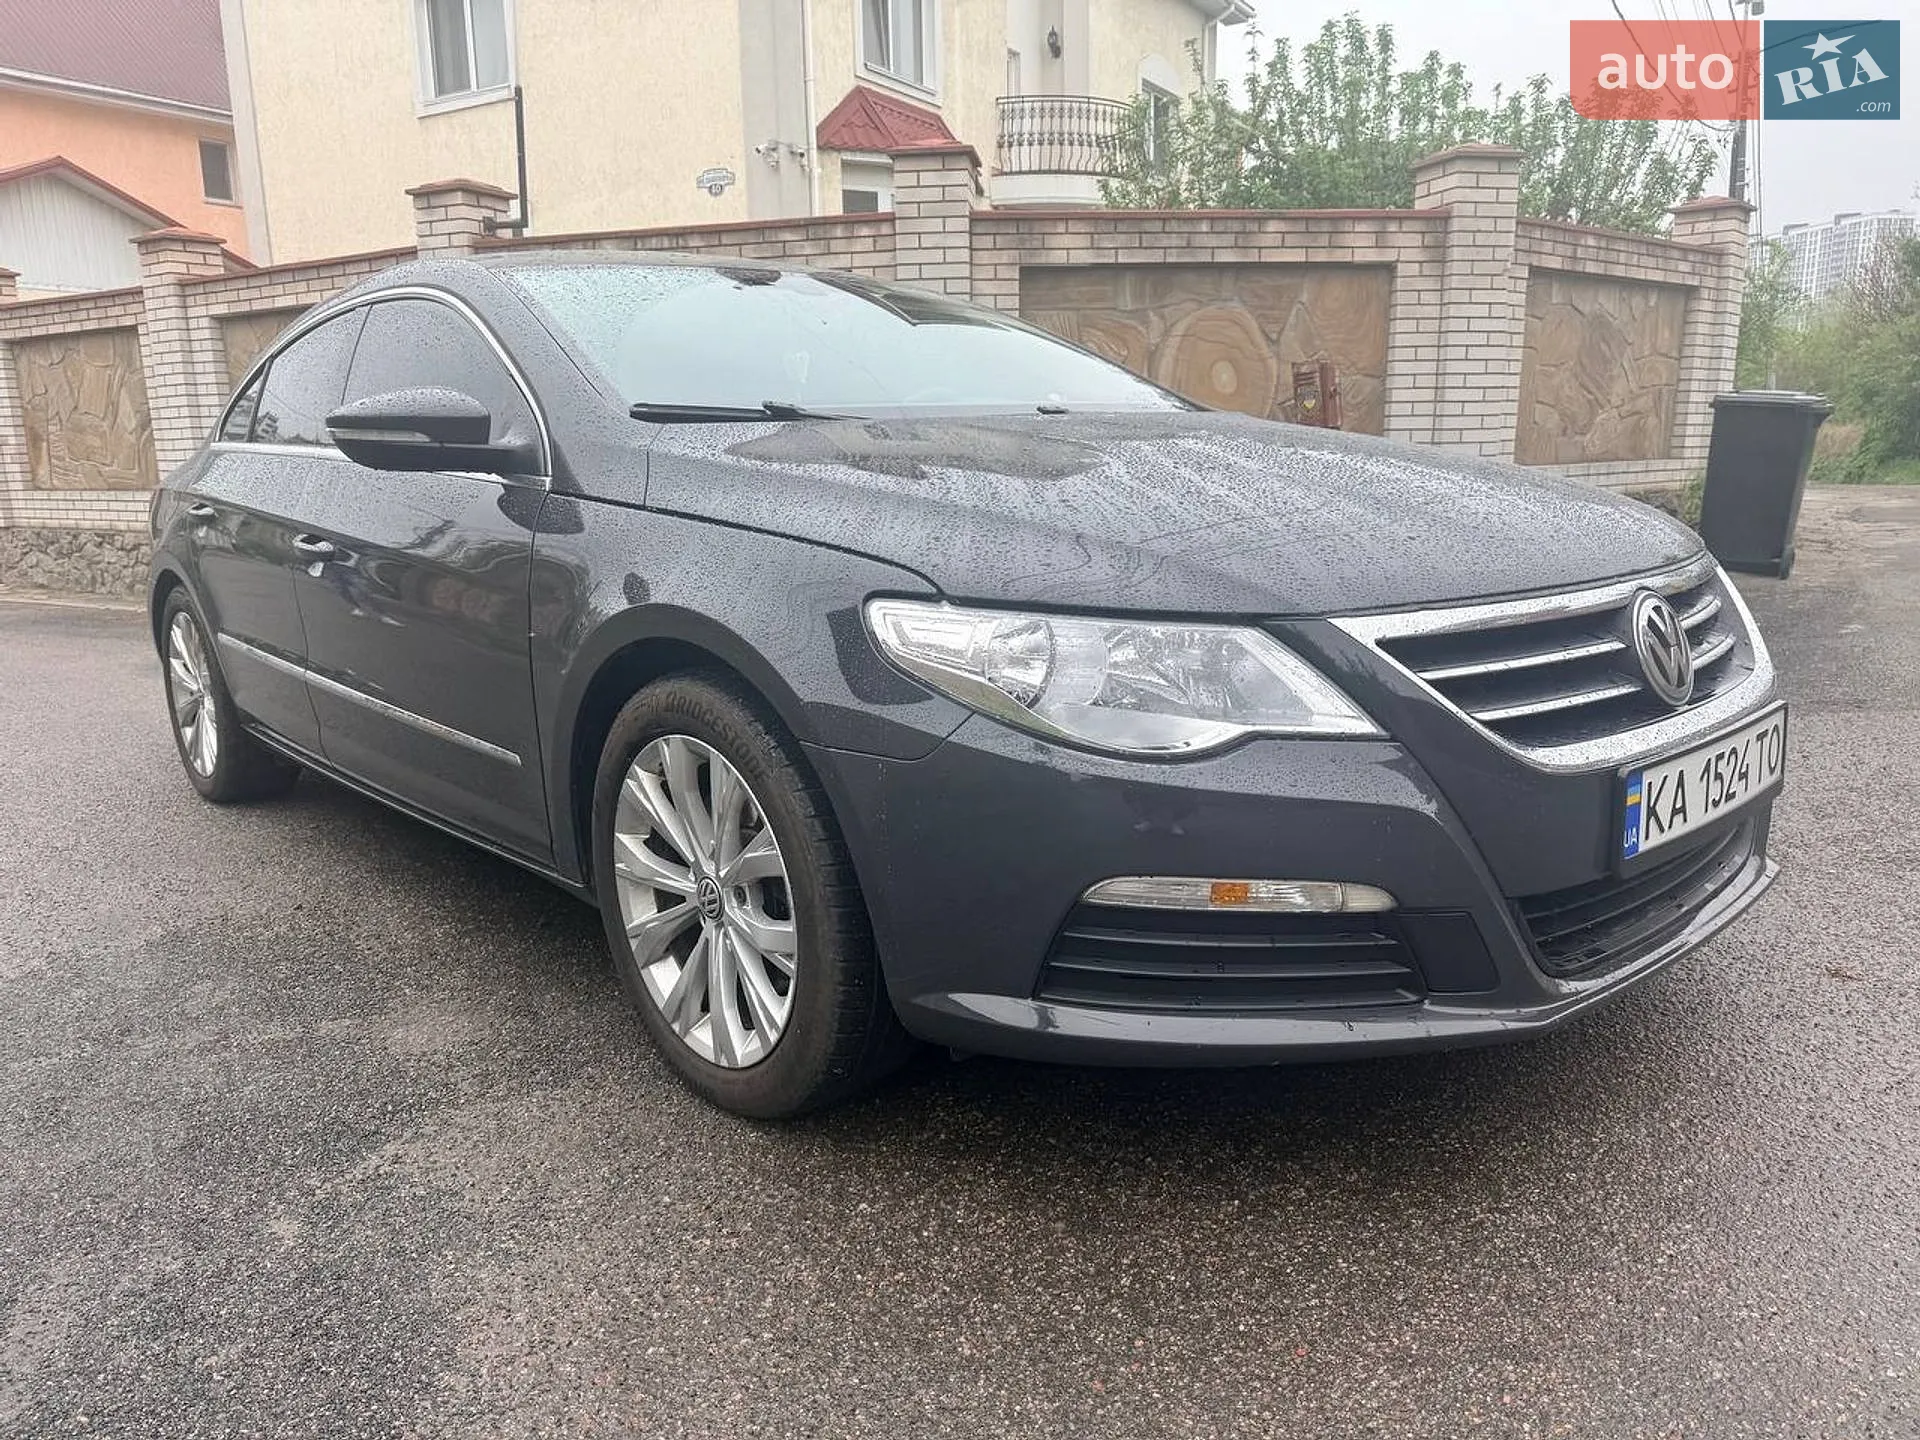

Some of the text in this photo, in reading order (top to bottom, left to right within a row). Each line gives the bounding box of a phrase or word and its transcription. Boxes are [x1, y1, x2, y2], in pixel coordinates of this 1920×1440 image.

[1644, 723, 1780, 841] KA 1524 TO
[1623, 827, 1638, 848] UA
